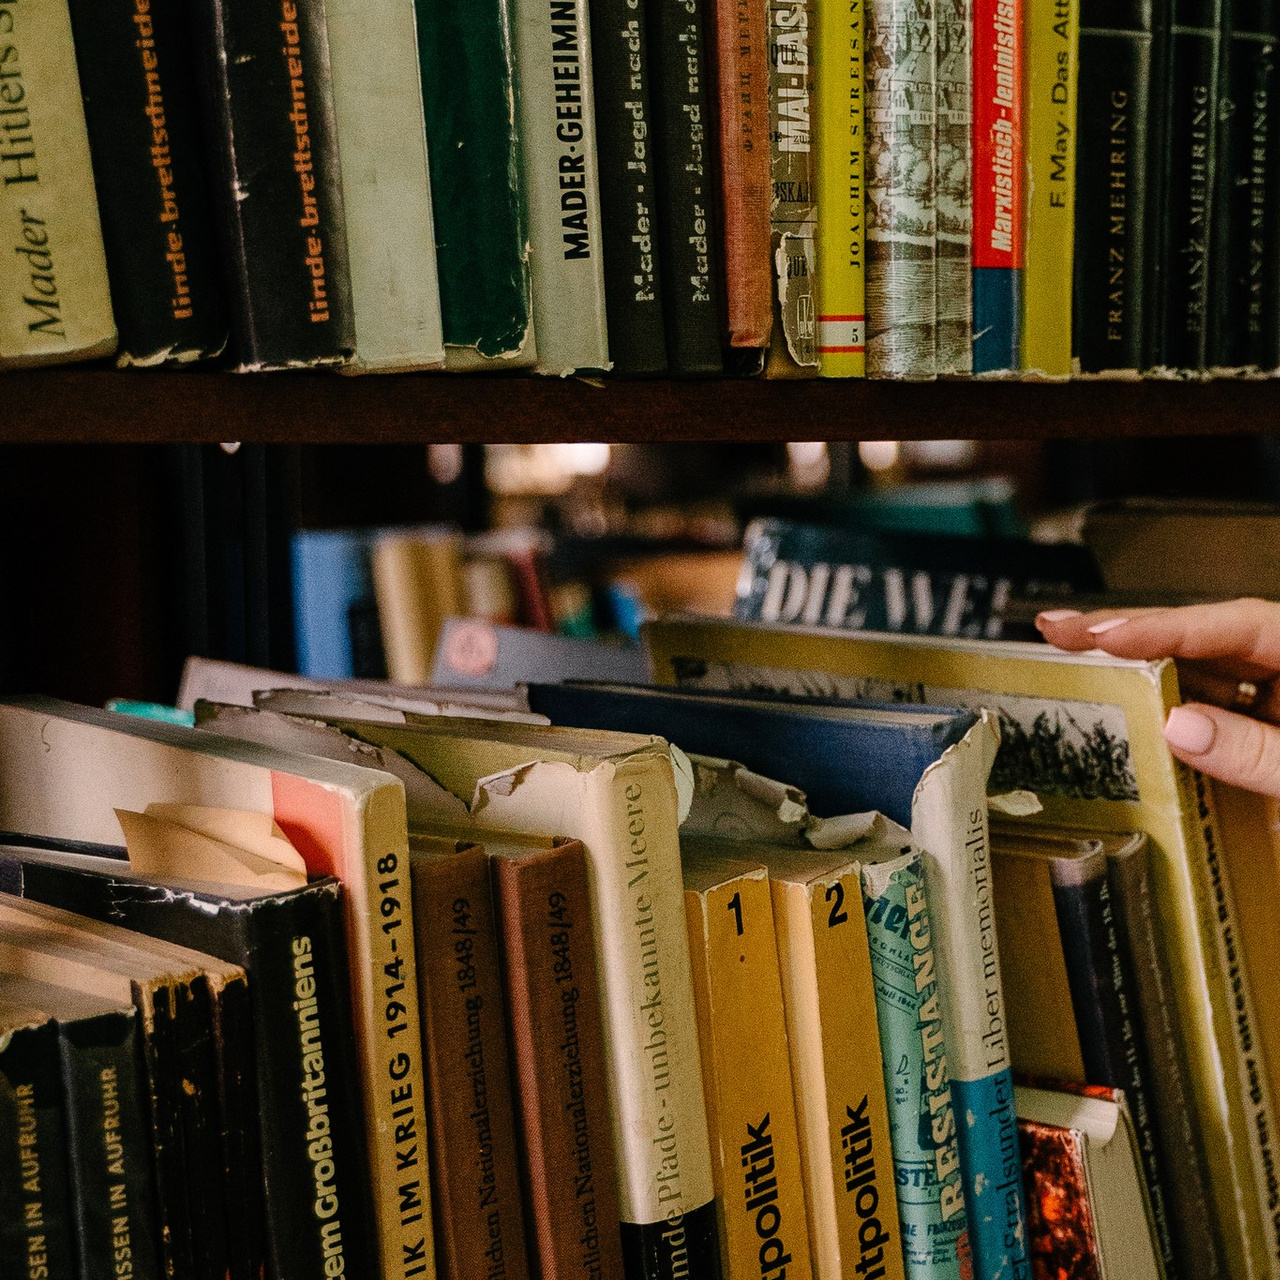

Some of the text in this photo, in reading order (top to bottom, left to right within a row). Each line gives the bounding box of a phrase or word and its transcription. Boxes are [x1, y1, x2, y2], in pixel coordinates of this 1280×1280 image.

[621, 19, 644, 91] nach
[678, 23, 701, 95] nach
[1051, 51, 1070, 104] Das
[624, 102, 649, 174] Jagd
[681, 103, 705, 177] Jagd
[1049, 121, 1071, 182] May
[1190, 85, 1209, 226] MEHRING
[1250, 89, 1268, 227] MEHRING
[557, 153, 591, 261] MADER
[849, 138, 862, 268] JOACHIM
[1049, 190, 1067, 209] F.
[1107, 88, 1129, 341] FRANZ MEHRING
[16, 208, 66, 338] Mader
[168, 231, 195, 320] linde
[304, 230, 331, 324] linde
[631, 202, 656, 302] Mader
[688, 203, 712, 303] Mader
[1186, 238, 1204, 334] FRANZ
[1249, 238, 1263, 334] FRANZ
[850, 327, 861, 344] 5
[619, 781, 651, 890] Meere
[547, 890, 575, 985] 1848/49
[727, 891, 746, 936] 1
[825, 882, 849, 928] 2
[965, 808, 999, 981] memorialis
[375, 851, 411, 1039] 1914-1918
[450, 896, 478, 993] 1848/49
[634, 891, 674, 1091] unbekannte
[983, 987, 1007, 1069] Liber
[99, 1066, 126, 1175] AUFRUHR
[290, 935, 340, 1219] Großbritanniens
[387, 1050, 419, 1171] KRIEG
[461, 994, 500, 1211] Nationalerziehung
[557, 987, 598, 1198] Nationalerziehung
[15, 1083, 41, 1193] AUFRUHR
[655, 1114, 685, 1205] Pfade
[988, 1075, 1024, 1250] Stralsunder
[23, 1202, 44, 1228] IN
[107, 1183, 128, 1210] IN
[397, 1180, 424, 1226] IM
